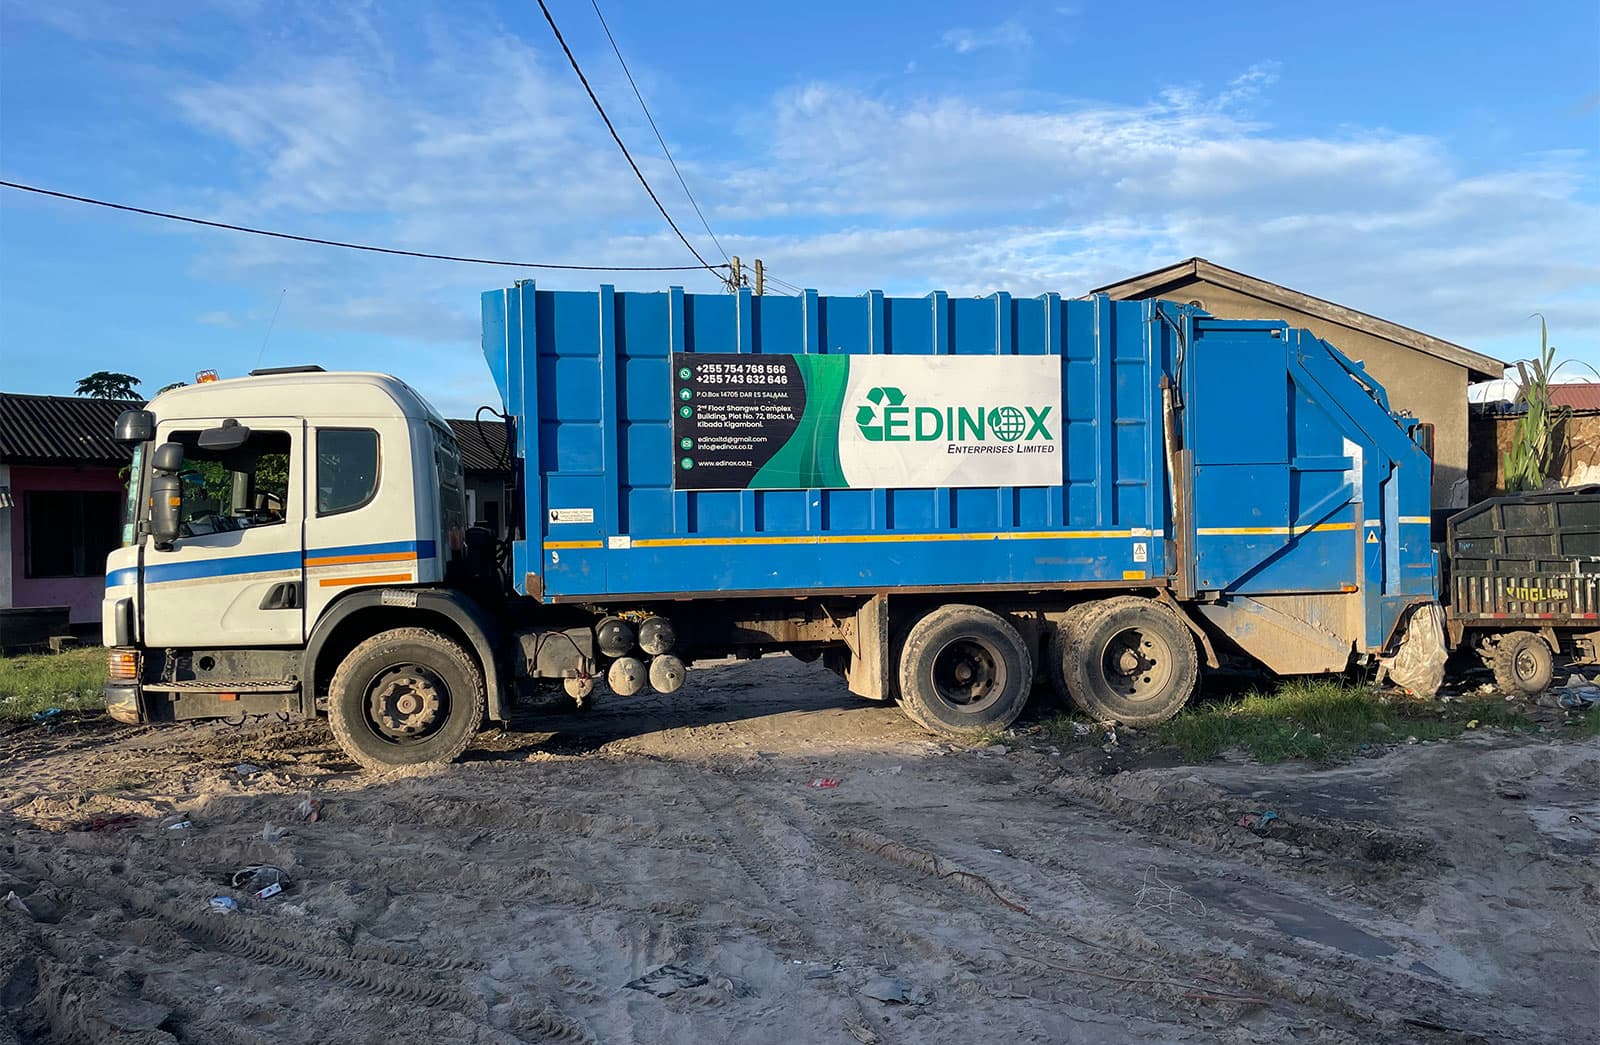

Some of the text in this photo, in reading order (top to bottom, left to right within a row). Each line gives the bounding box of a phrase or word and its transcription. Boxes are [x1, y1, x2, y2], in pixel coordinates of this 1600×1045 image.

[696, 364, 786, 374] +255 754 768 566
[696, 375, 788, 385] +255 743 632 646
[726, 405, 759, 413] Shangwe
[760, 405, 792, 413] Complex
[884, 406, 1054, 442] EDINOX
[947, 443, 1055, 454] ENTERPRISES LIMITED
